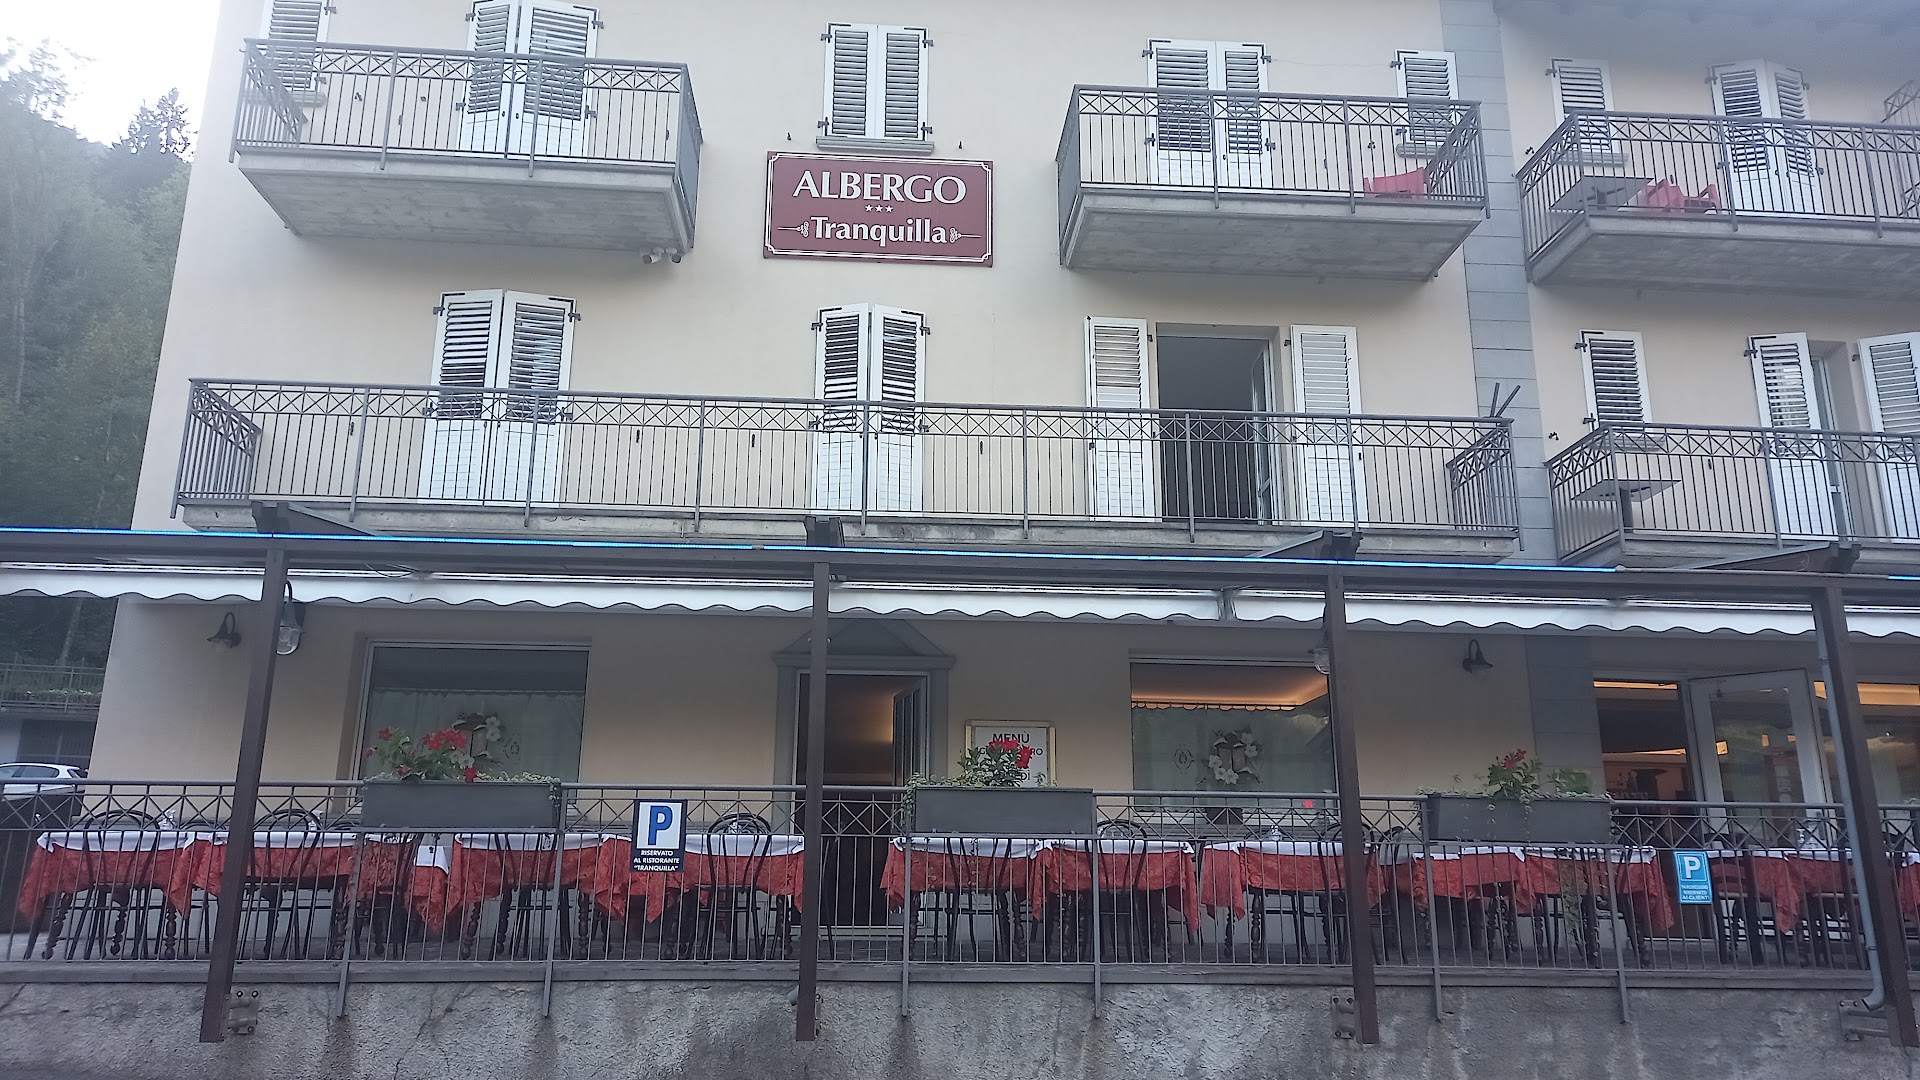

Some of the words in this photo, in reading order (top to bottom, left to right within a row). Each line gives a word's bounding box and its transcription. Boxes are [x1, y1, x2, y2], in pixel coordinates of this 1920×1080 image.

[792, 170, 967, 204] ALBERGO
[810, 216, 948, 247] Tranquilla
[648, 806, 673, 845] P
[1683, 856, 1701, 878] P
